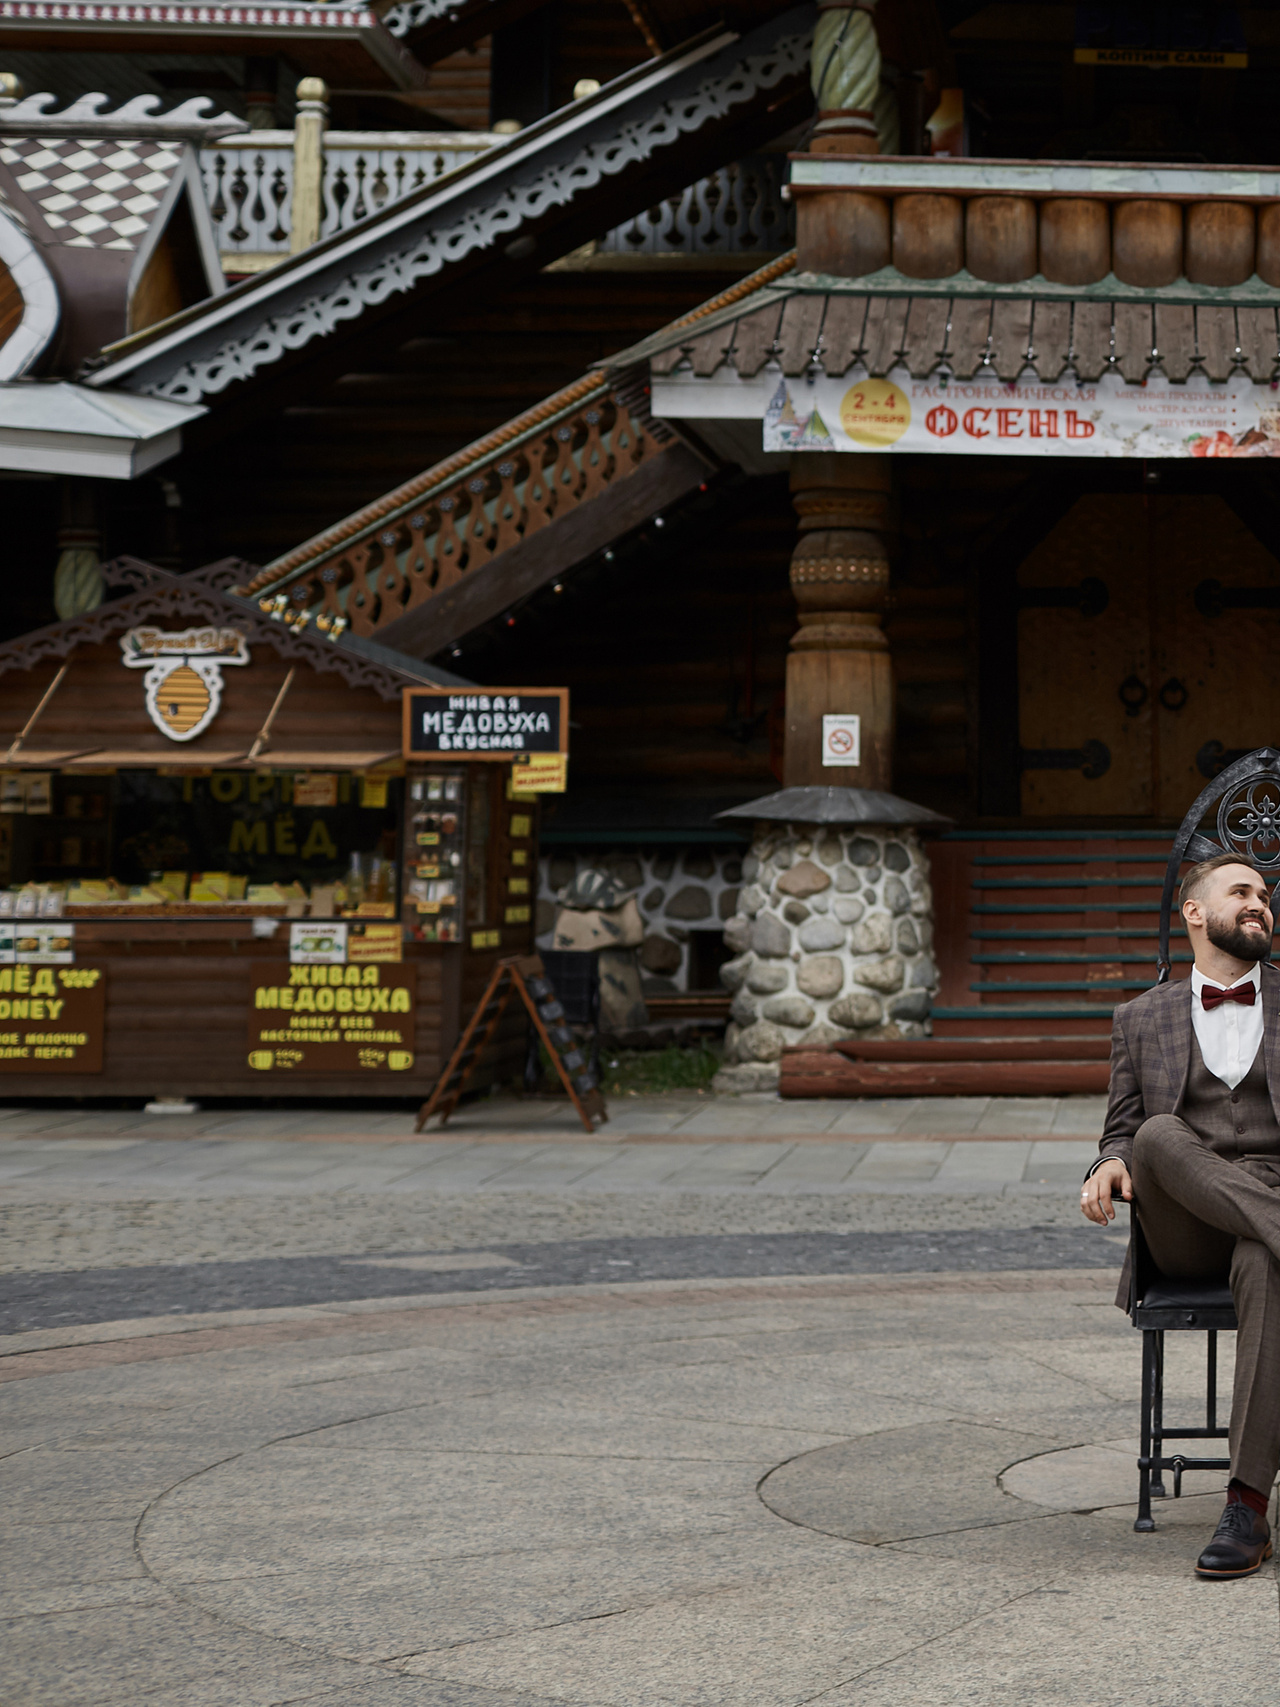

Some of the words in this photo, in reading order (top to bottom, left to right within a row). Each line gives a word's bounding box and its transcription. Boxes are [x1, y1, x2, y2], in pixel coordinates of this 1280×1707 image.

[1097, 51, 1169, 62] КОПТИМ
[1175, 53, 1225, 64] САМИ
[854, 392, 865, 410] 2
[884, 392, 896, 410] 4
[912, 384, 1096, 401] ГАСТРОНОМИЧЕСКАЯ
[925, 404, 1095, 439] ОСЕНЬ
[449, 695, 520, 712] ЖИВАЯ
[422, 711, 551, 735] МЕДОВУХА
[438, 733, 525, 750] ВКУСНАЯ
[228, 810, 338, 861] МЁД
[288, 965, 380, 987] ЖИВАЯ
[255, 986, 411, 1013] МЕДОВУХА
[0, 999, 65, 1020] ONEY
[289, 1015, 336, 1029] HONEY
[339, 1015, 374, 1029] BEER
[34, 1047, 76, 1059] ПЕРГА
